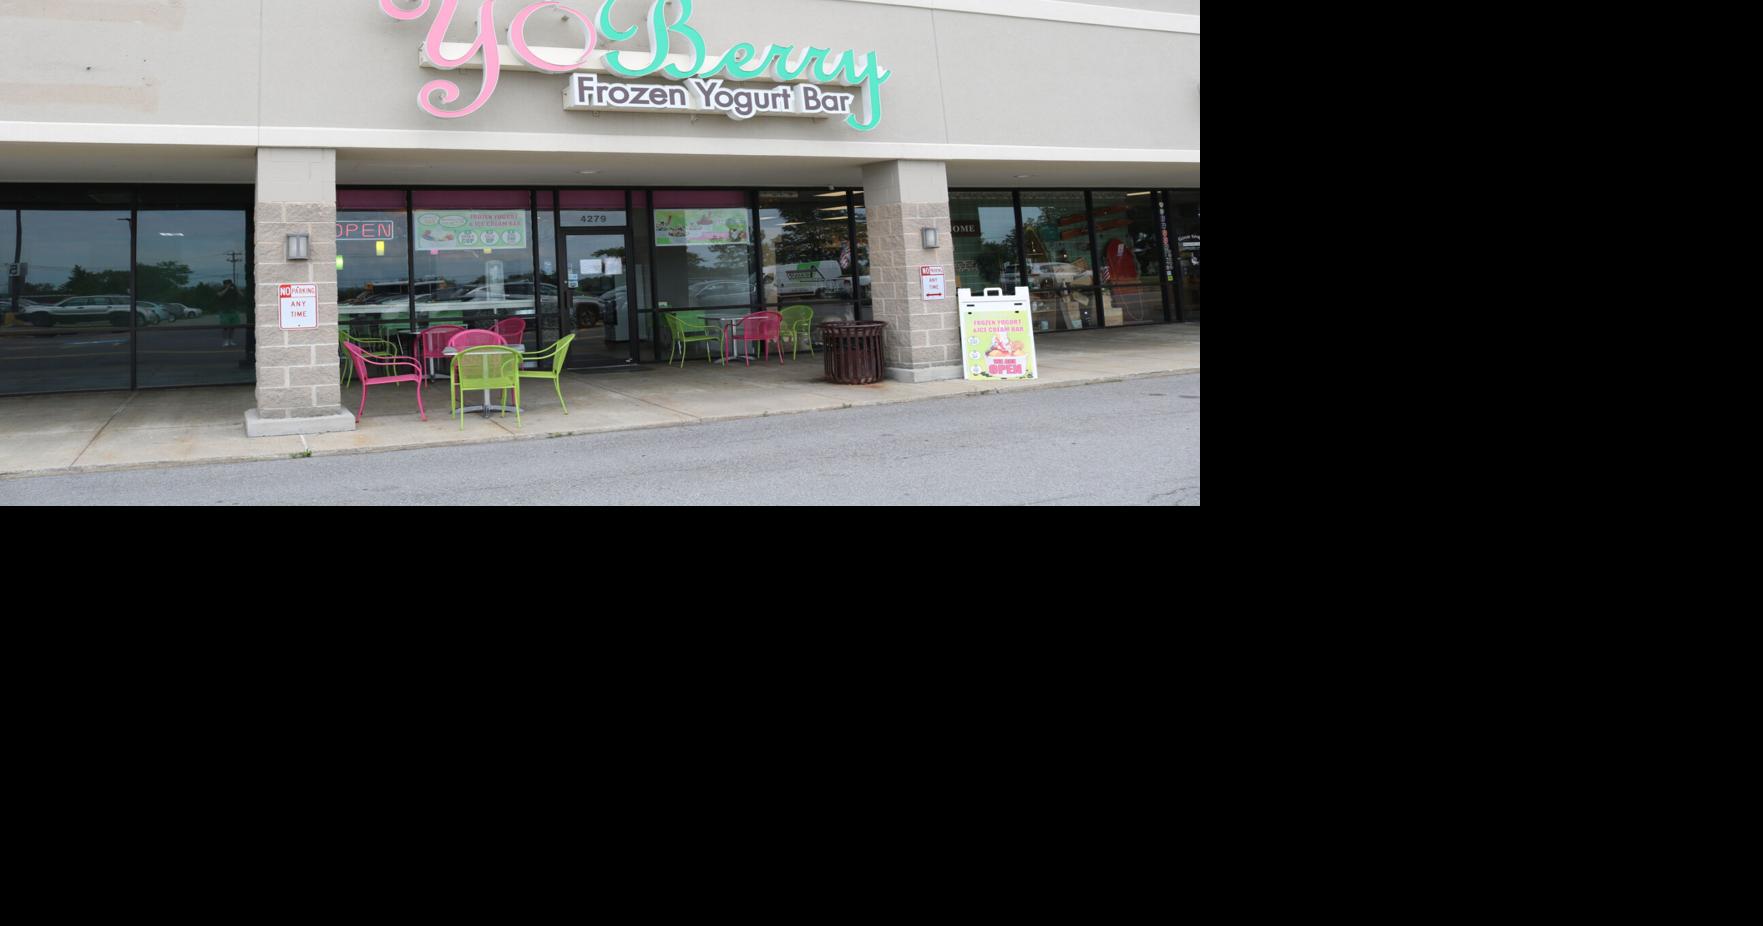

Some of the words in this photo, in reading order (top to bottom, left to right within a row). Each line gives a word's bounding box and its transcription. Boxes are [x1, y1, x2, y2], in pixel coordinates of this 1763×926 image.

[577, 74, 688, 108] Frozen
[697, 80, 791, 117] Yogurt
[803, 84, 851, 113] Bar
[580, 215, 607, 223] 4279
[952, 224, 976, 232] OME
[280, 287, 291, 296] NO
[988, 364, 1023, 375] OPEN
